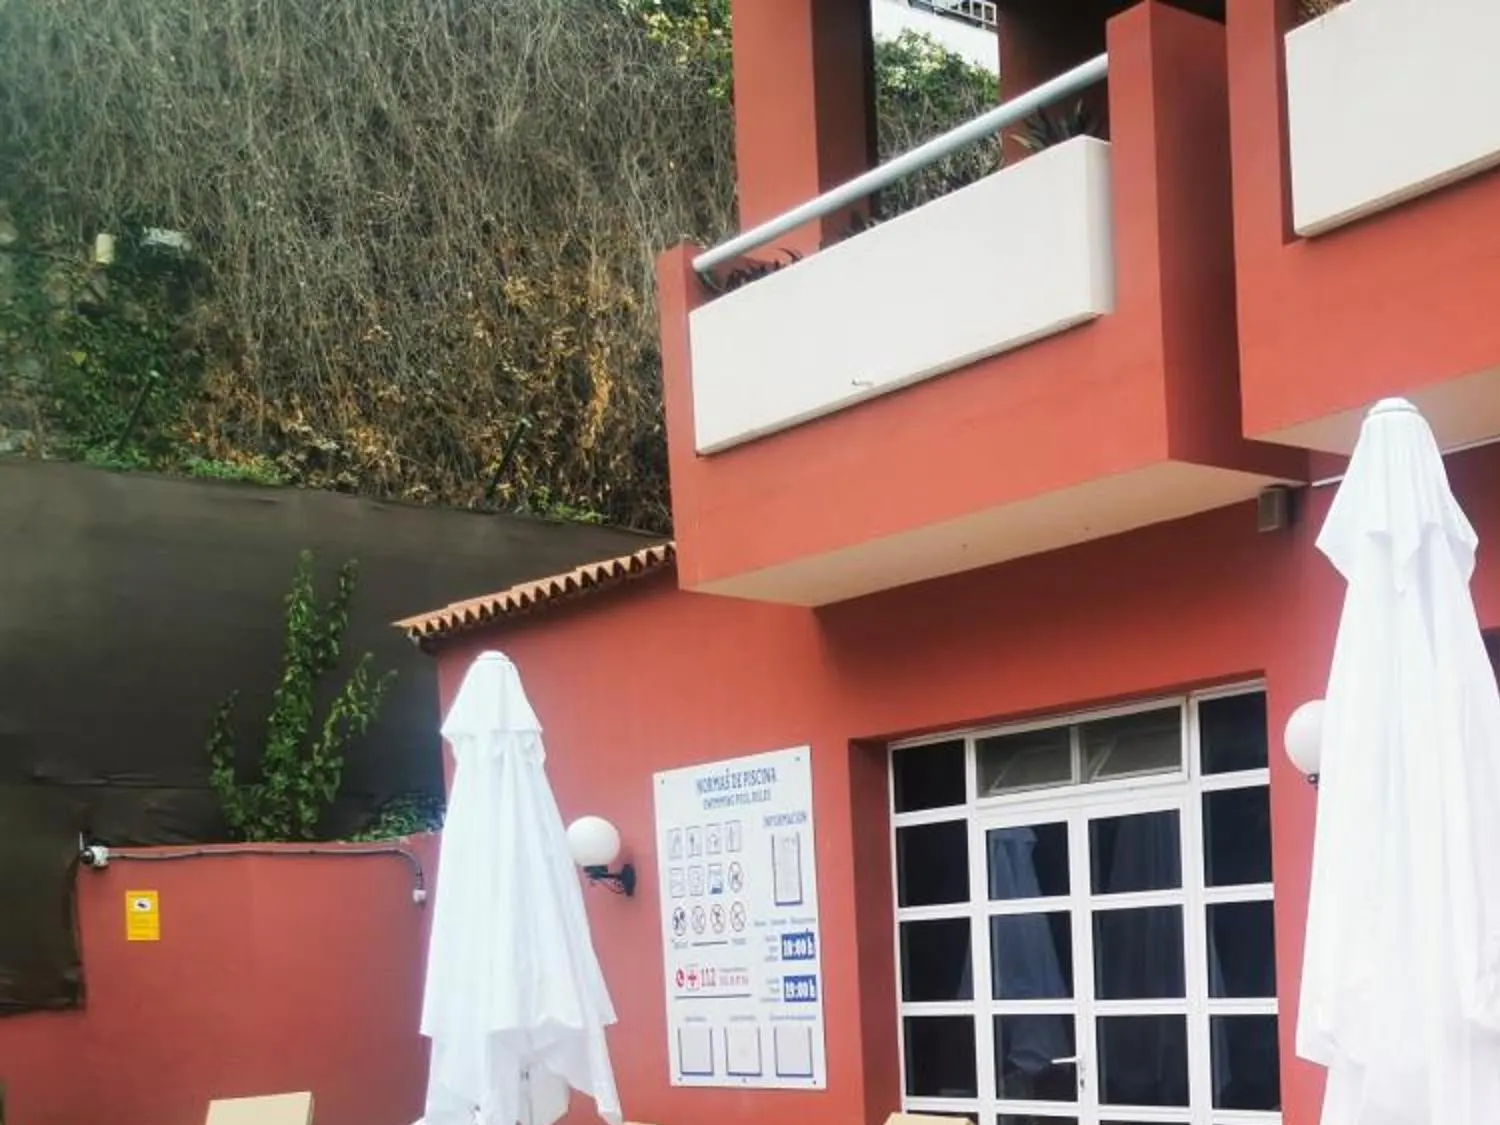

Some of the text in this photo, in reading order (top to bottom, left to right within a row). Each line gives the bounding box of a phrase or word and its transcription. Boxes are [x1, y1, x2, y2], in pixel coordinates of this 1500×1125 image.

[731, 772, 743, 789] DE
[743, 767, 776, 786] PISCINA
[701, 968, 716, 987] 112
